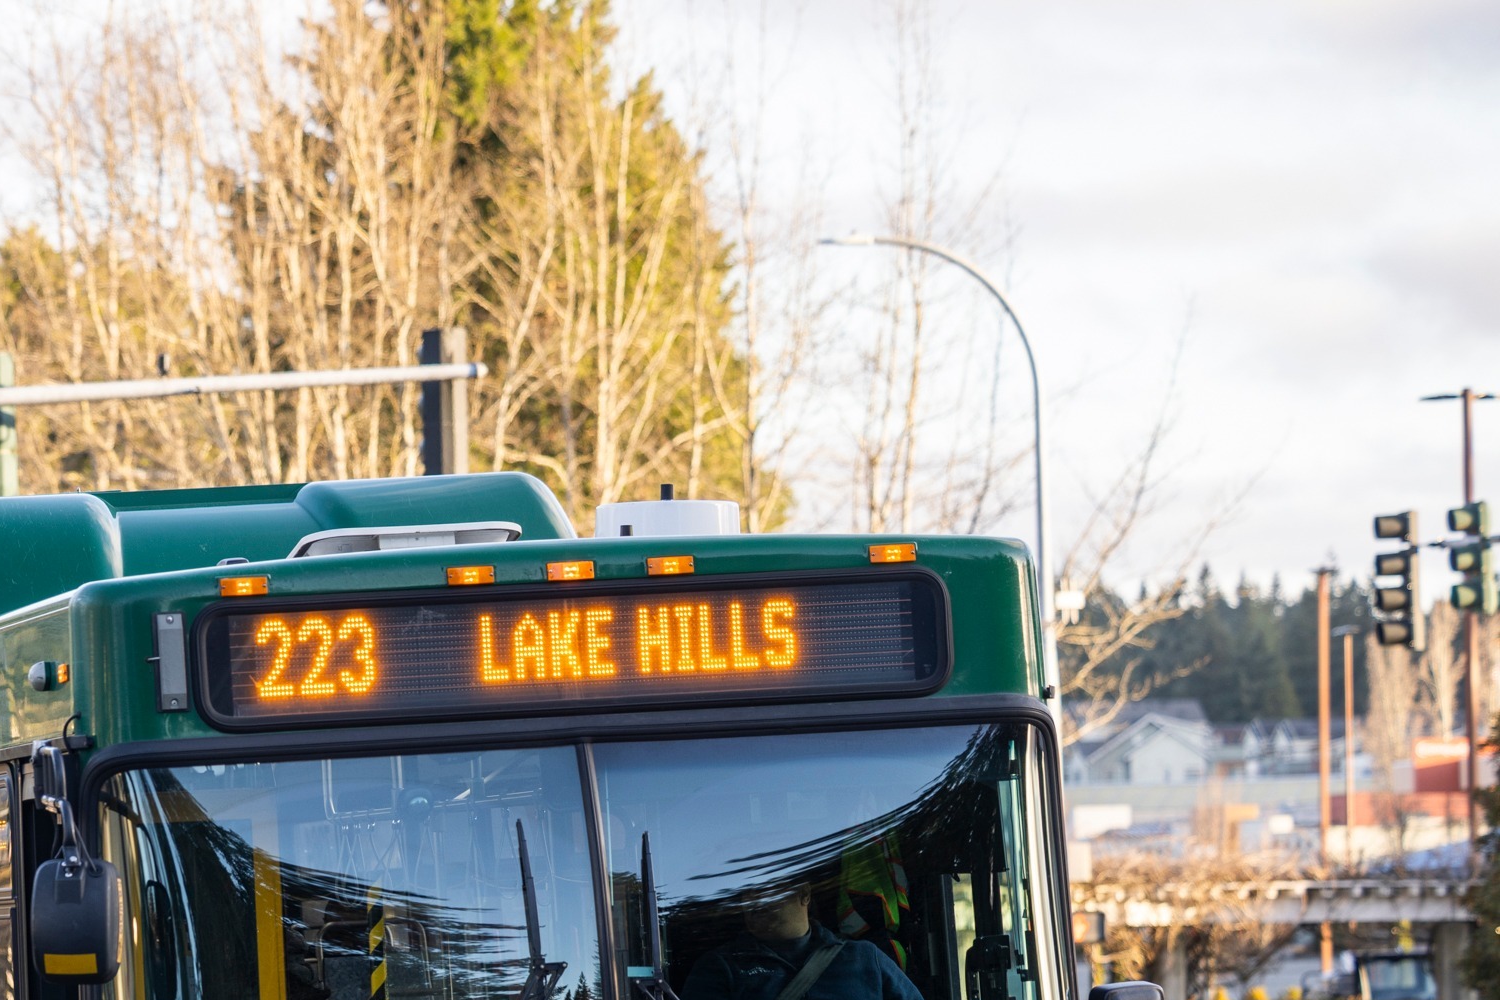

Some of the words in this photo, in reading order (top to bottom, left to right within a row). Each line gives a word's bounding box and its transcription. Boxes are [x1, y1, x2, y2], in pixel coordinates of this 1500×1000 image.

[257, 617, 375, 697] 223
[480, 608, 615, 681] LAKE
[638, 600, 795, 673] HILLS
